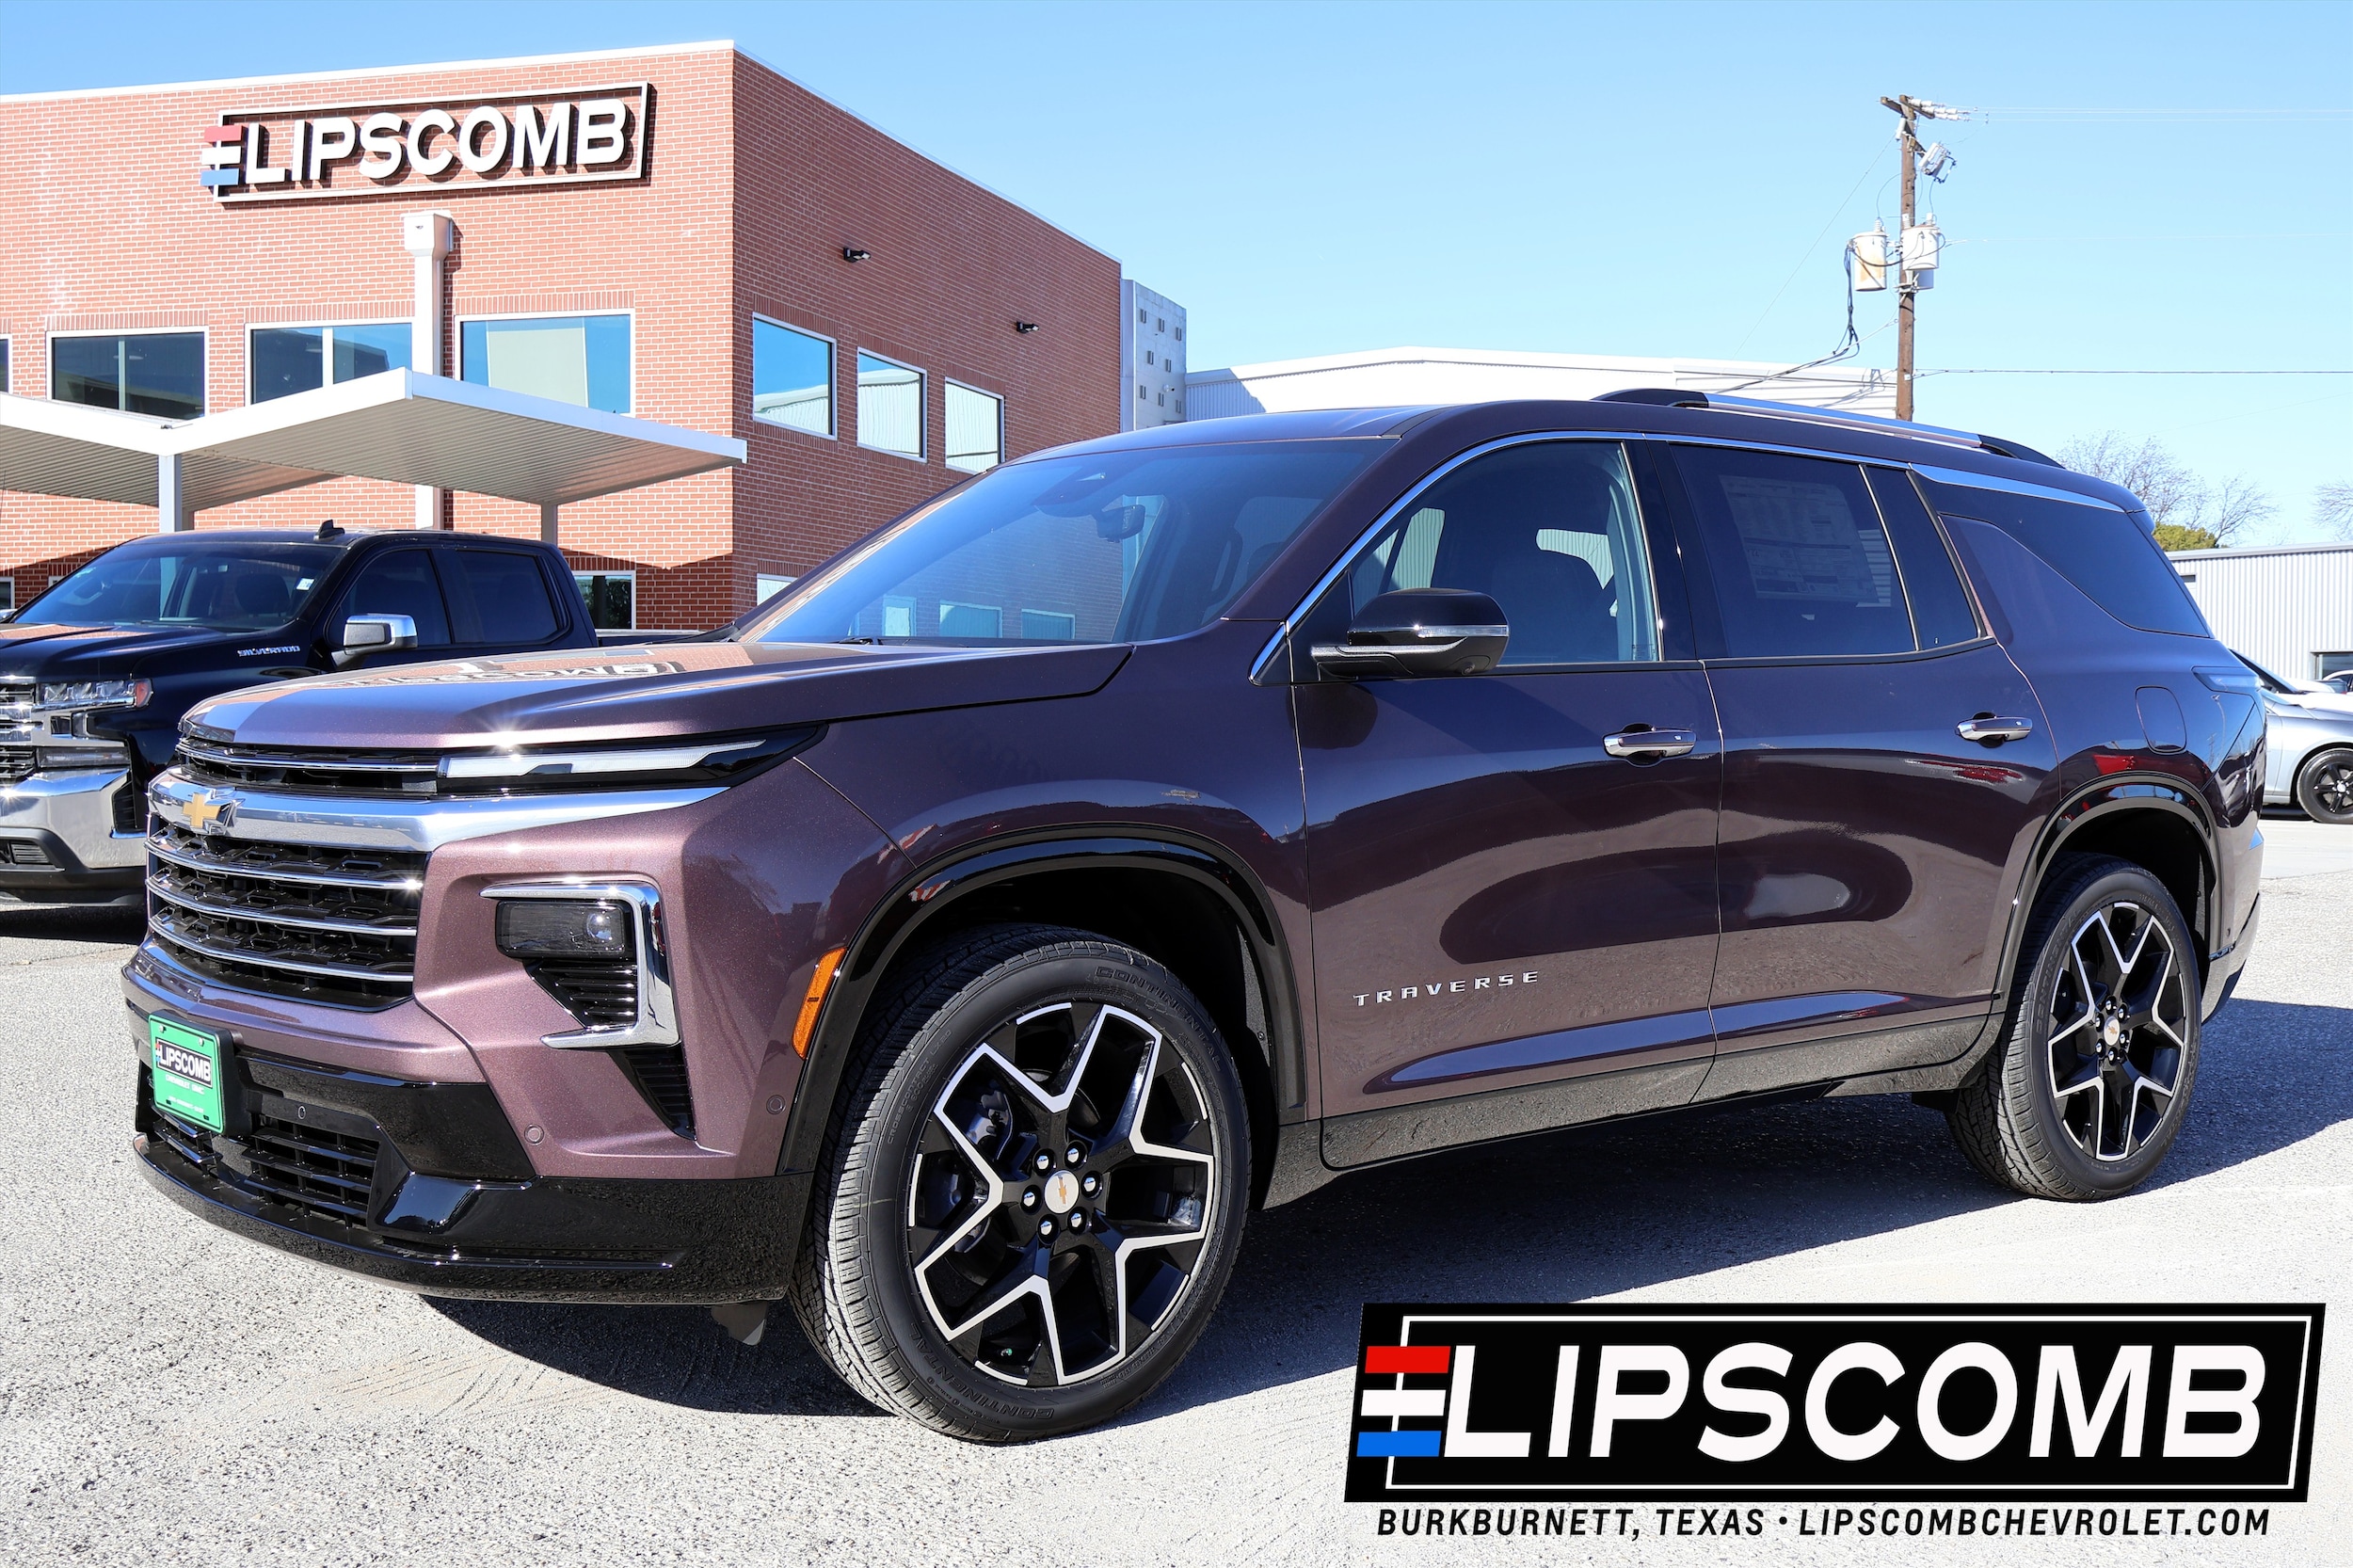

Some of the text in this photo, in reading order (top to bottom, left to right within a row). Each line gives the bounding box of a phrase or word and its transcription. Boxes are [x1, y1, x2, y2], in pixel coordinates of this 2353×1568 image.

[246, 99, 628, 184] LIPSCOMB
[237, 646, 300, 657] SILVERADO
[1353, 971, 1539, 1006] TRAVERSE
[1095, 966, 1223, 1072] CONTINENTAL
[160, 1045, 211, 1081] LIPSCOMB
[908, 1322, 1055, 1420] CONTINENTAL
